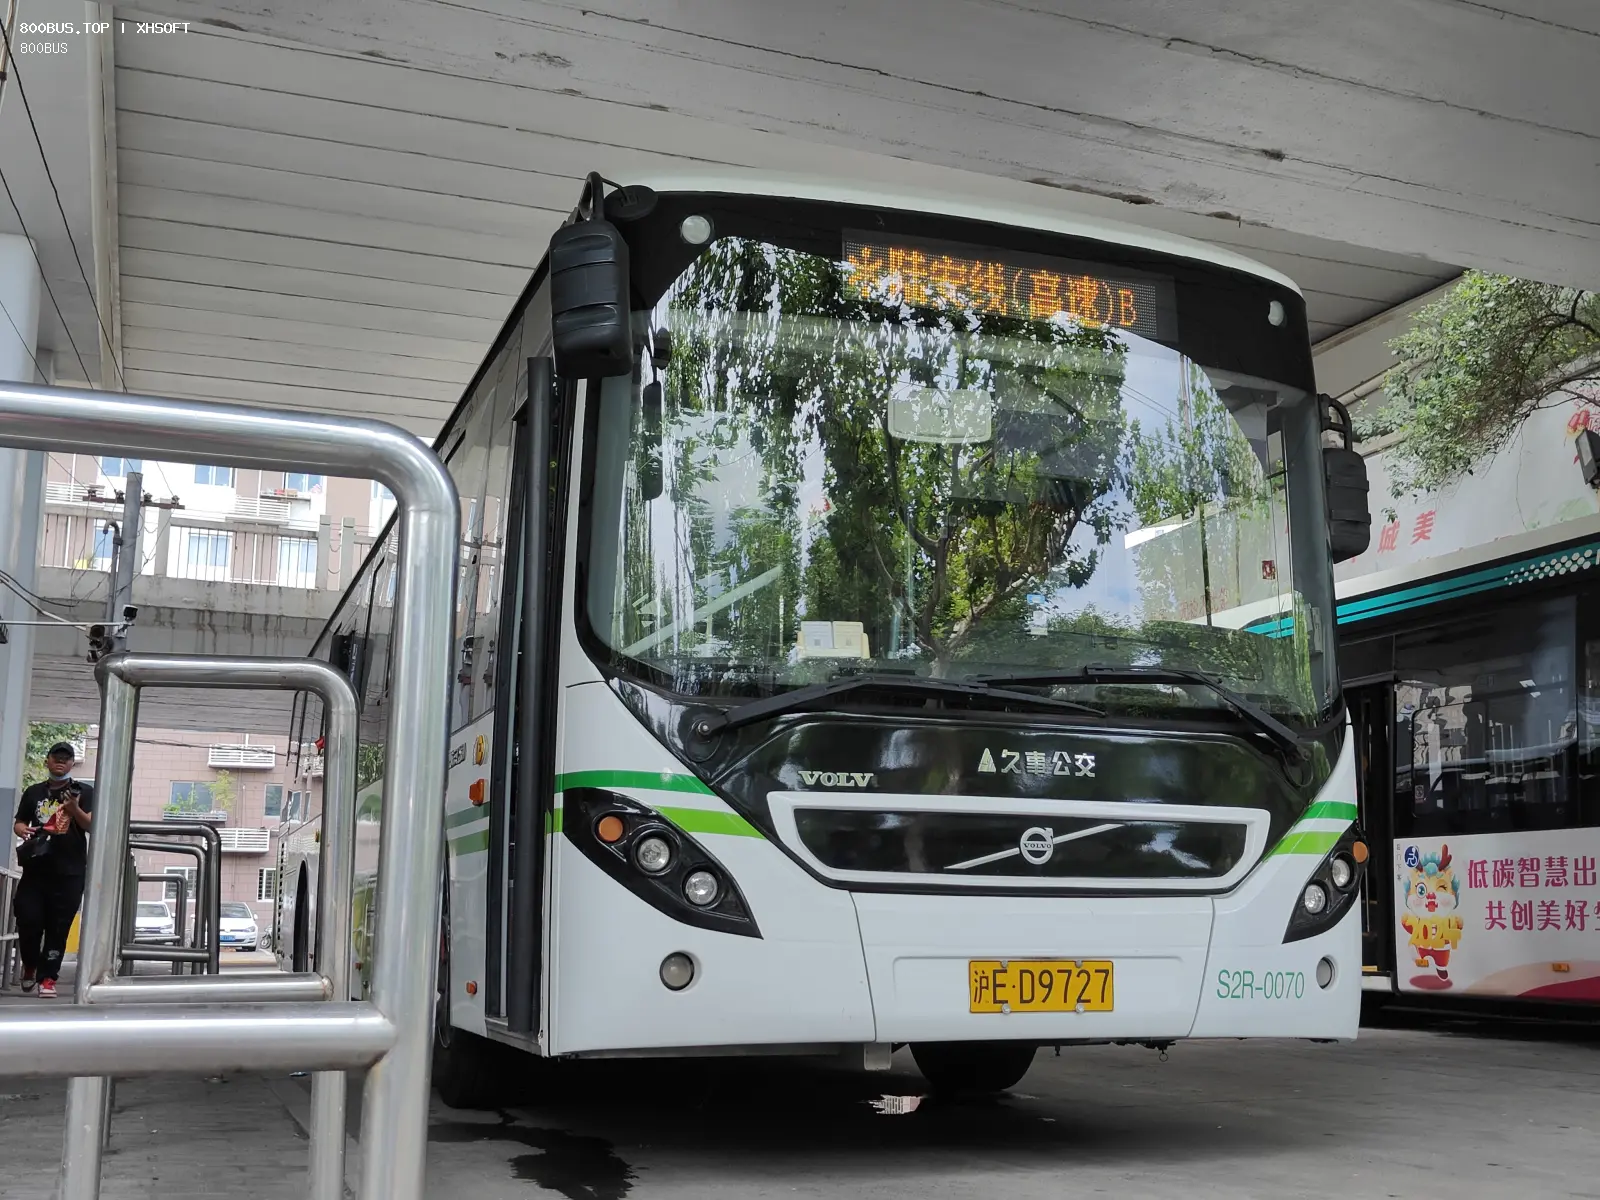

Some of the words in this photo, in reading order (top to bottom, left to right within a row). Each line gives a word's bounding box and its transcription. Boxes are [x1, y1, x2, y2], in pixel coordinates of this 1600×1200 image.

[1001, 748, 1096, 778] 久事公交
[1023, 841, 1052, 850] VOLVO
[1467, 855, 1597, 889] 低碳智慧出
[1484, 899, 1600, 932] 共创美好
[1216, 968, 1306, 1001] S2R-0070
